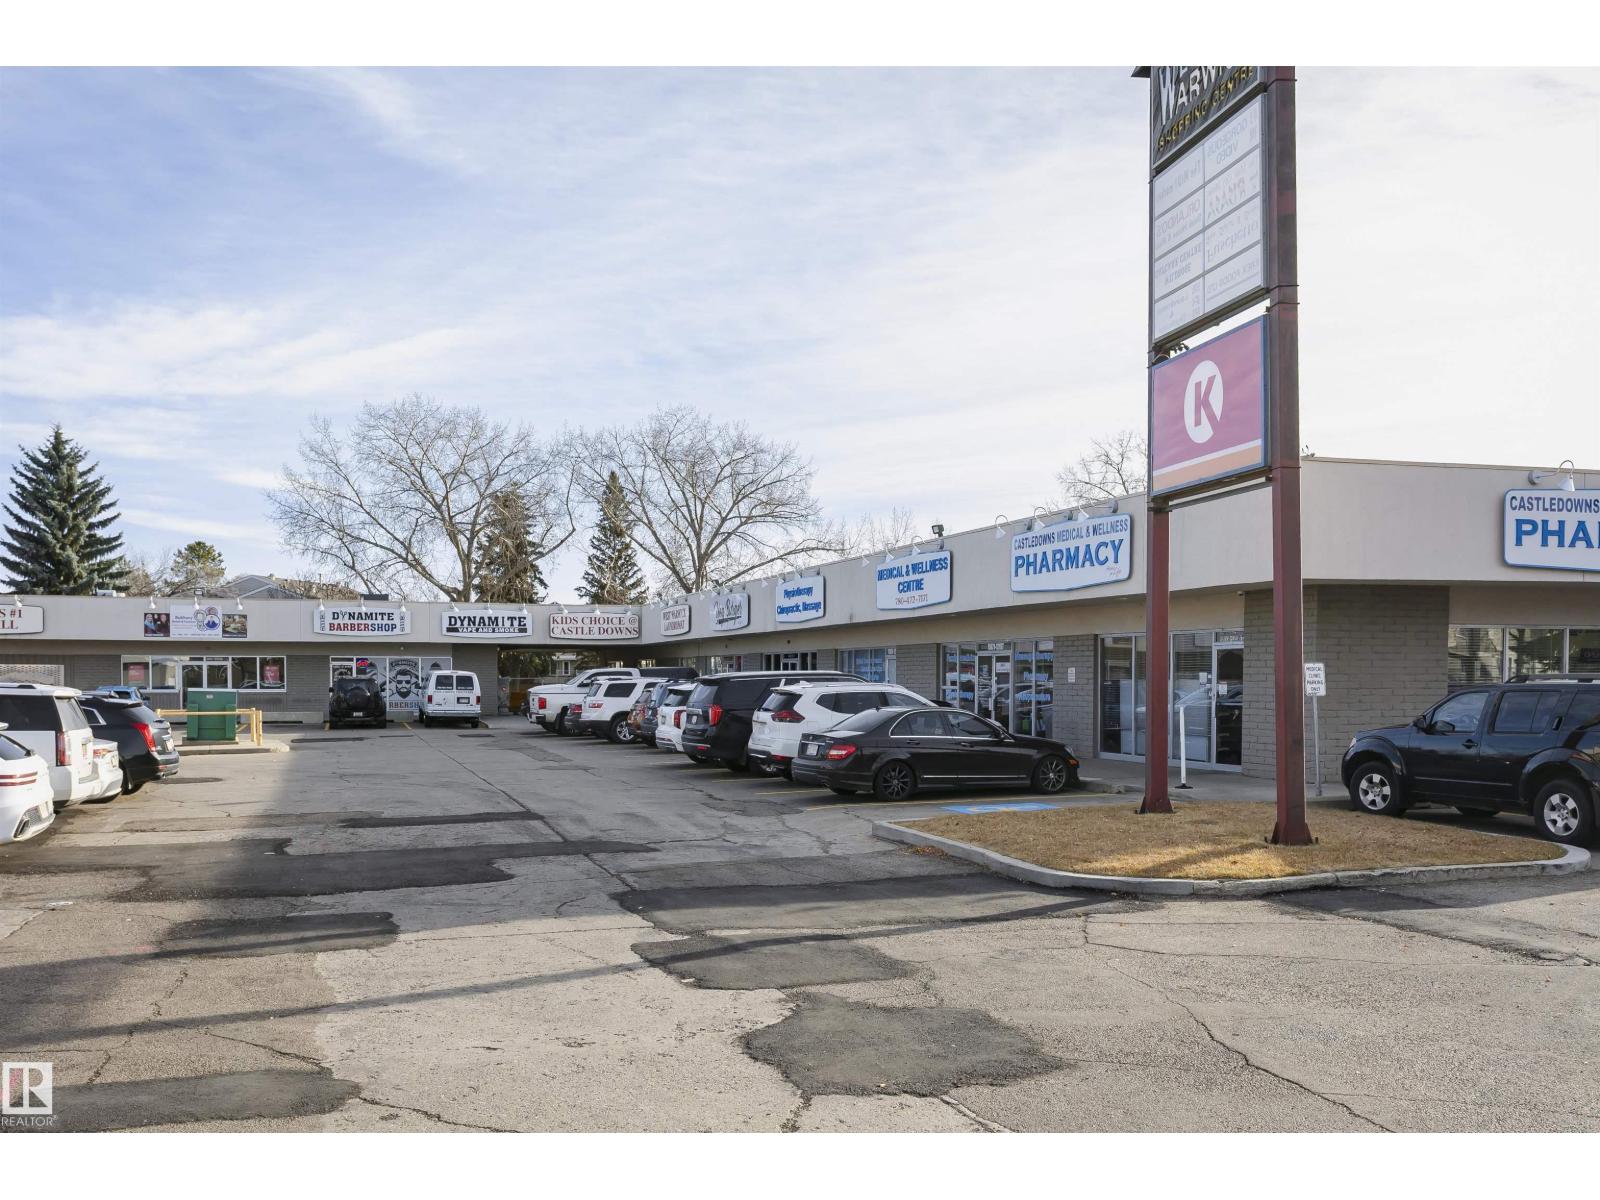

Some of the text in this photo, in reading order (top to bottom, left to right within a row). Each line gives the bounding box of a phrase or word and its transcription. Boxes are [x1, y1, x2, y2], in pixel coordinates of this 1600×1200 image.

[1159, 66, 1233, 125] WARW
[1158, 100, 1208, 150] SHOPPING
[1212, 66, 1253, 107] CENTRE
[1194, 374, 1219, 434] K
[1510, 495, 1600, 513] CASTLEDOWNS
[1014, 518, 1129, 550] CASTLEDOWNS MEDICAL & WELLNESS
[1514, 518, 1600, 549] PHA
[1014, 538, 1124, 577] PHARMACY
[877, 556, 949, 581] MEDICAL & WELLNESS
[898, 578, 924, 594] CENTRE
[332, 610, 394, 621] DYNAMITE
[448, 615, 527, 627] DYNAMITE
[552, 616, 638, 625] KIDS CHOICE @
[329, 622, 397, 632] BARBERSHOP
[552, 626, 639, 636] CASTLE DOWNS
